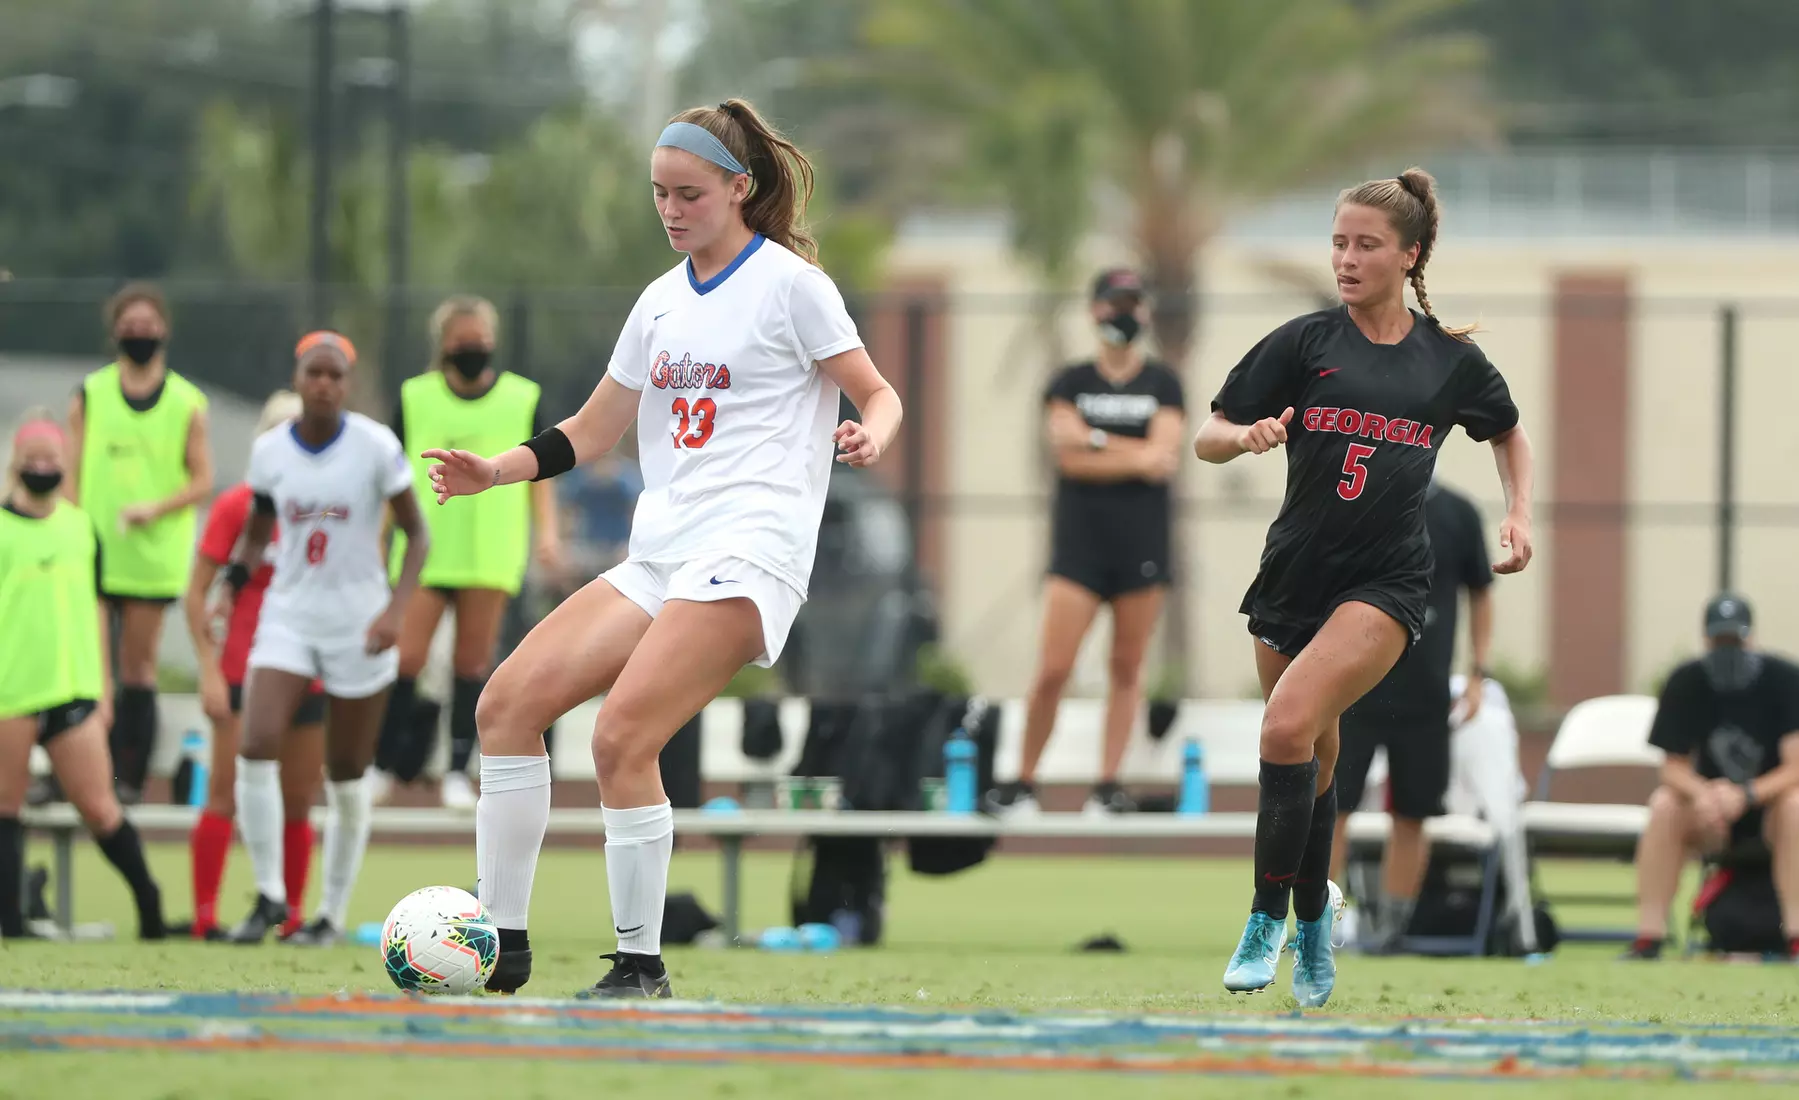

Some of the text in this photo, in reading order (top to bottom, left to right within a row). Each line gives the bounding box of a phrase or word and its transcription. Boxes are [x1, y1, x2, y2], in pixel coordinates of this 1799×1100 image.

[651, 350, 731, 389] Gators
[1302, 407, 1434, 449] GEORGIA
[1336, 442, 1377, 501] 5
